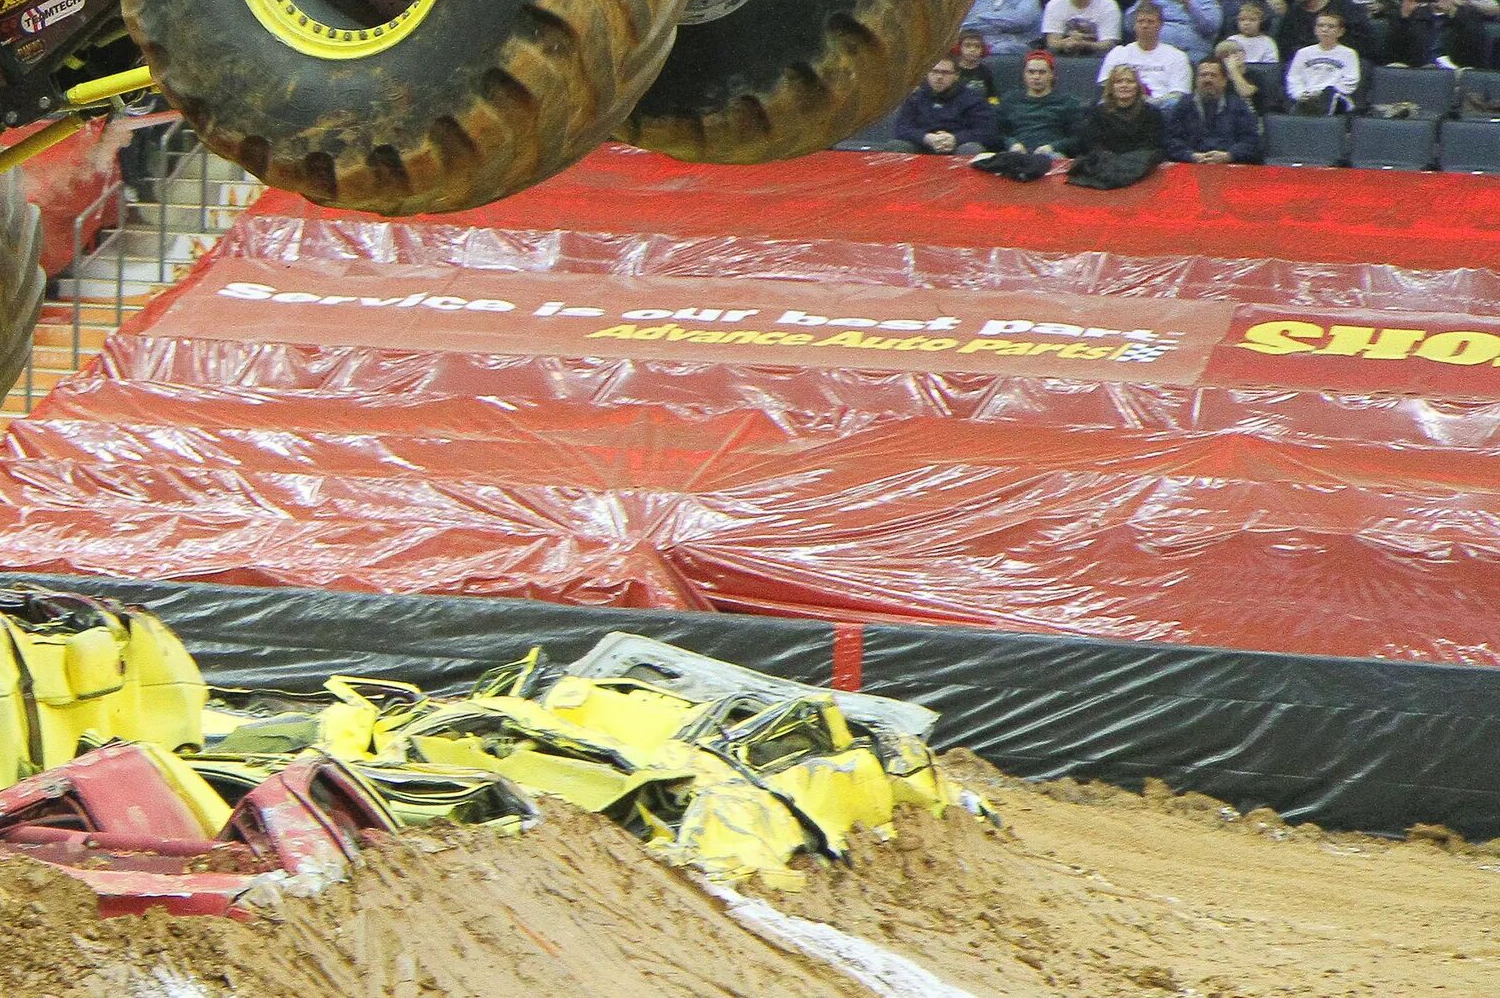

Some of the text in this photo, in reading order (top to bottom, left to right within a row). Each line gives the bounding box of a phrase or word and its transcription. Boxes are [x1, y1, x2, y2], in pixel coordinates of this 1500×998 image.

[217, 282, 516, 313] Service
[534, 301, 607, 319] is
[621, 307, 761, 323] our
[775, 311, 962, 332] best
[585, 323, 1114, 360] Advance Auto Parts
[1242, 320, 1500, 367] SHO
